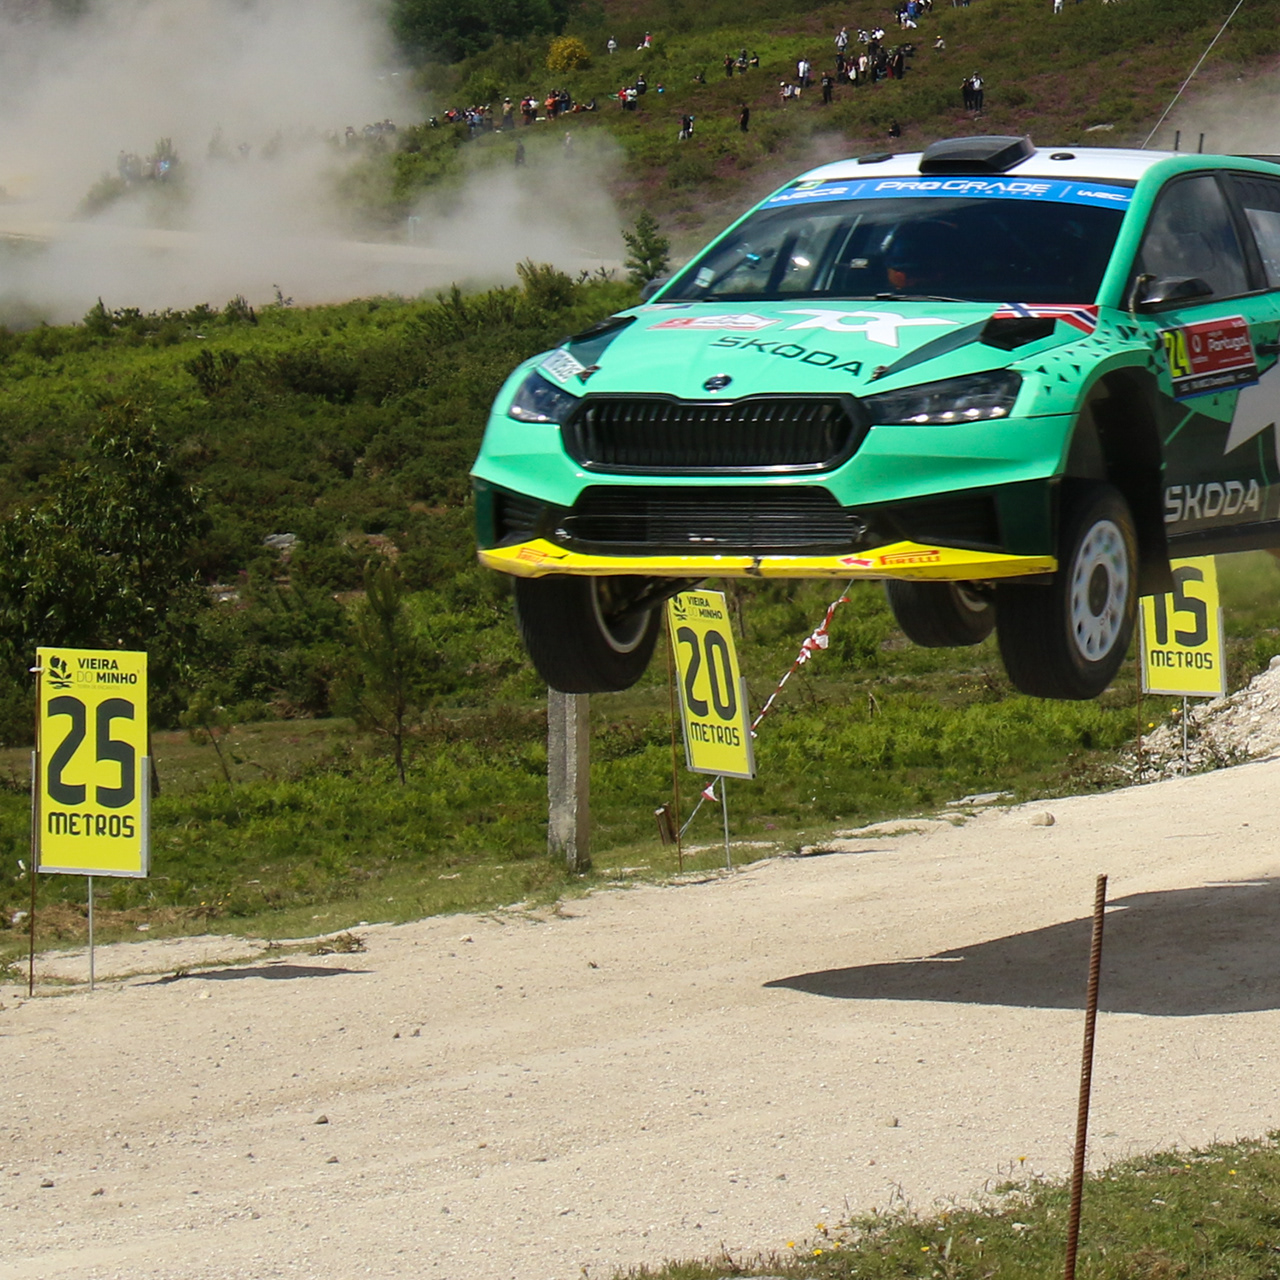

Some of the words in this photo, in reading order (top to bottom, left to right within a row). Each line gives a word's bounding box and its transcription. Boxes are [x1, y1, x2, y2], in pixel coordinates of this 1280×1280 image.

[1162, 329, 1192, 378] 24
[878, 550, 941, 566] PIRELLI
[686, 595, 711, 608] VIEIRA
[1153, 565, 1208, 647] 15
[698, 608, 723, 620] MINHO
[77, 658, 119, 671] VIEIRA
[1150, 649, 1213, 670] METROS
[77, 670, 94, 684] DO
[96, 671, 138, 685] MINHO
[676, 626, 737, 721] 20
[690, 721, 740, 747] METROS
[47, 695, 136, 809] 25
[48, 811, 135, 838] METROS
